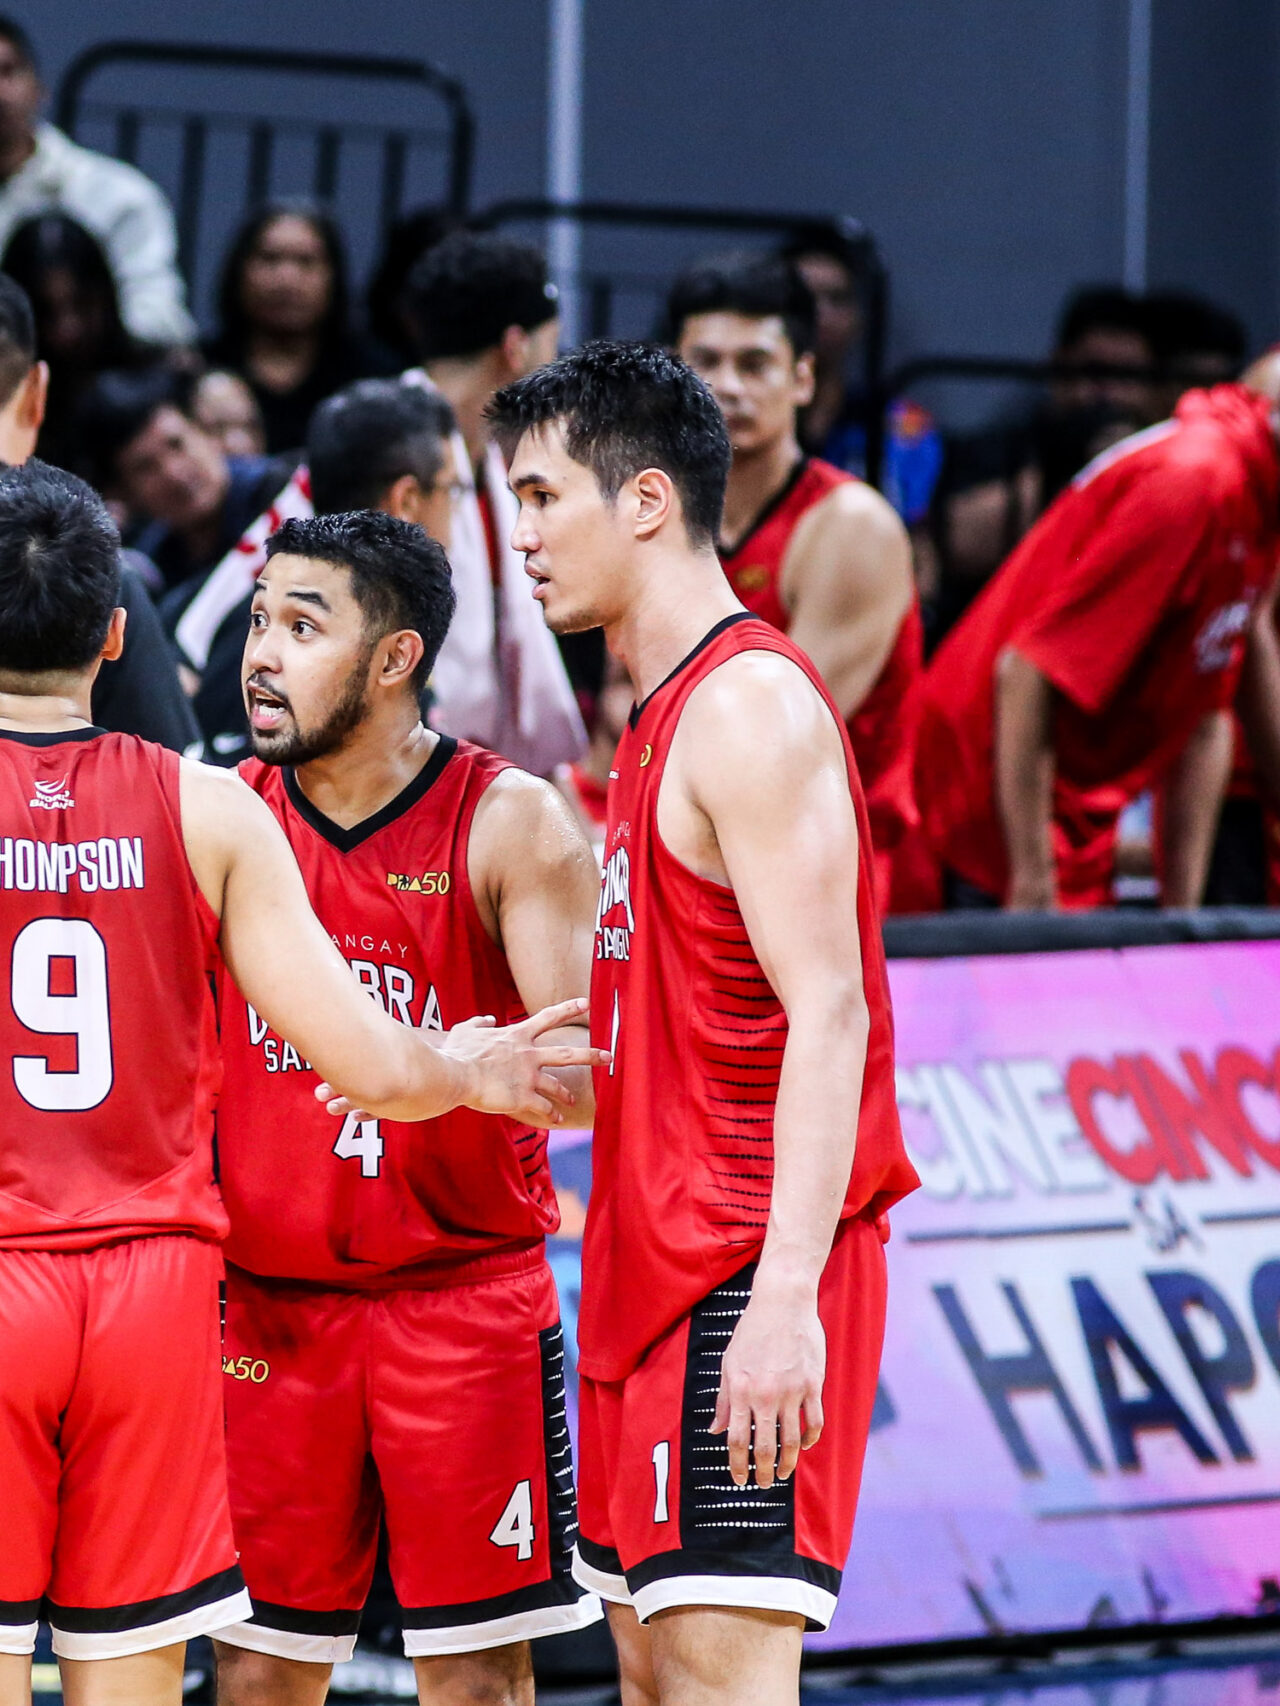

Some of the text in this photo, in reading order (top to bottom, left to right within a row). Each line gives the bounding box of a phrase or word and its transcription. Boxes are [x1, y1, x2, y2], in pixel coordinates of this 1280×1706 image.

[331, 933, 408, 959] ANGAY
[10, 916, 114, 1112] 9
[332, 1111, 384, 1178] 4
[489, 1479, 535, 1561] 4
[652, 1440, 671, 1523] 1
